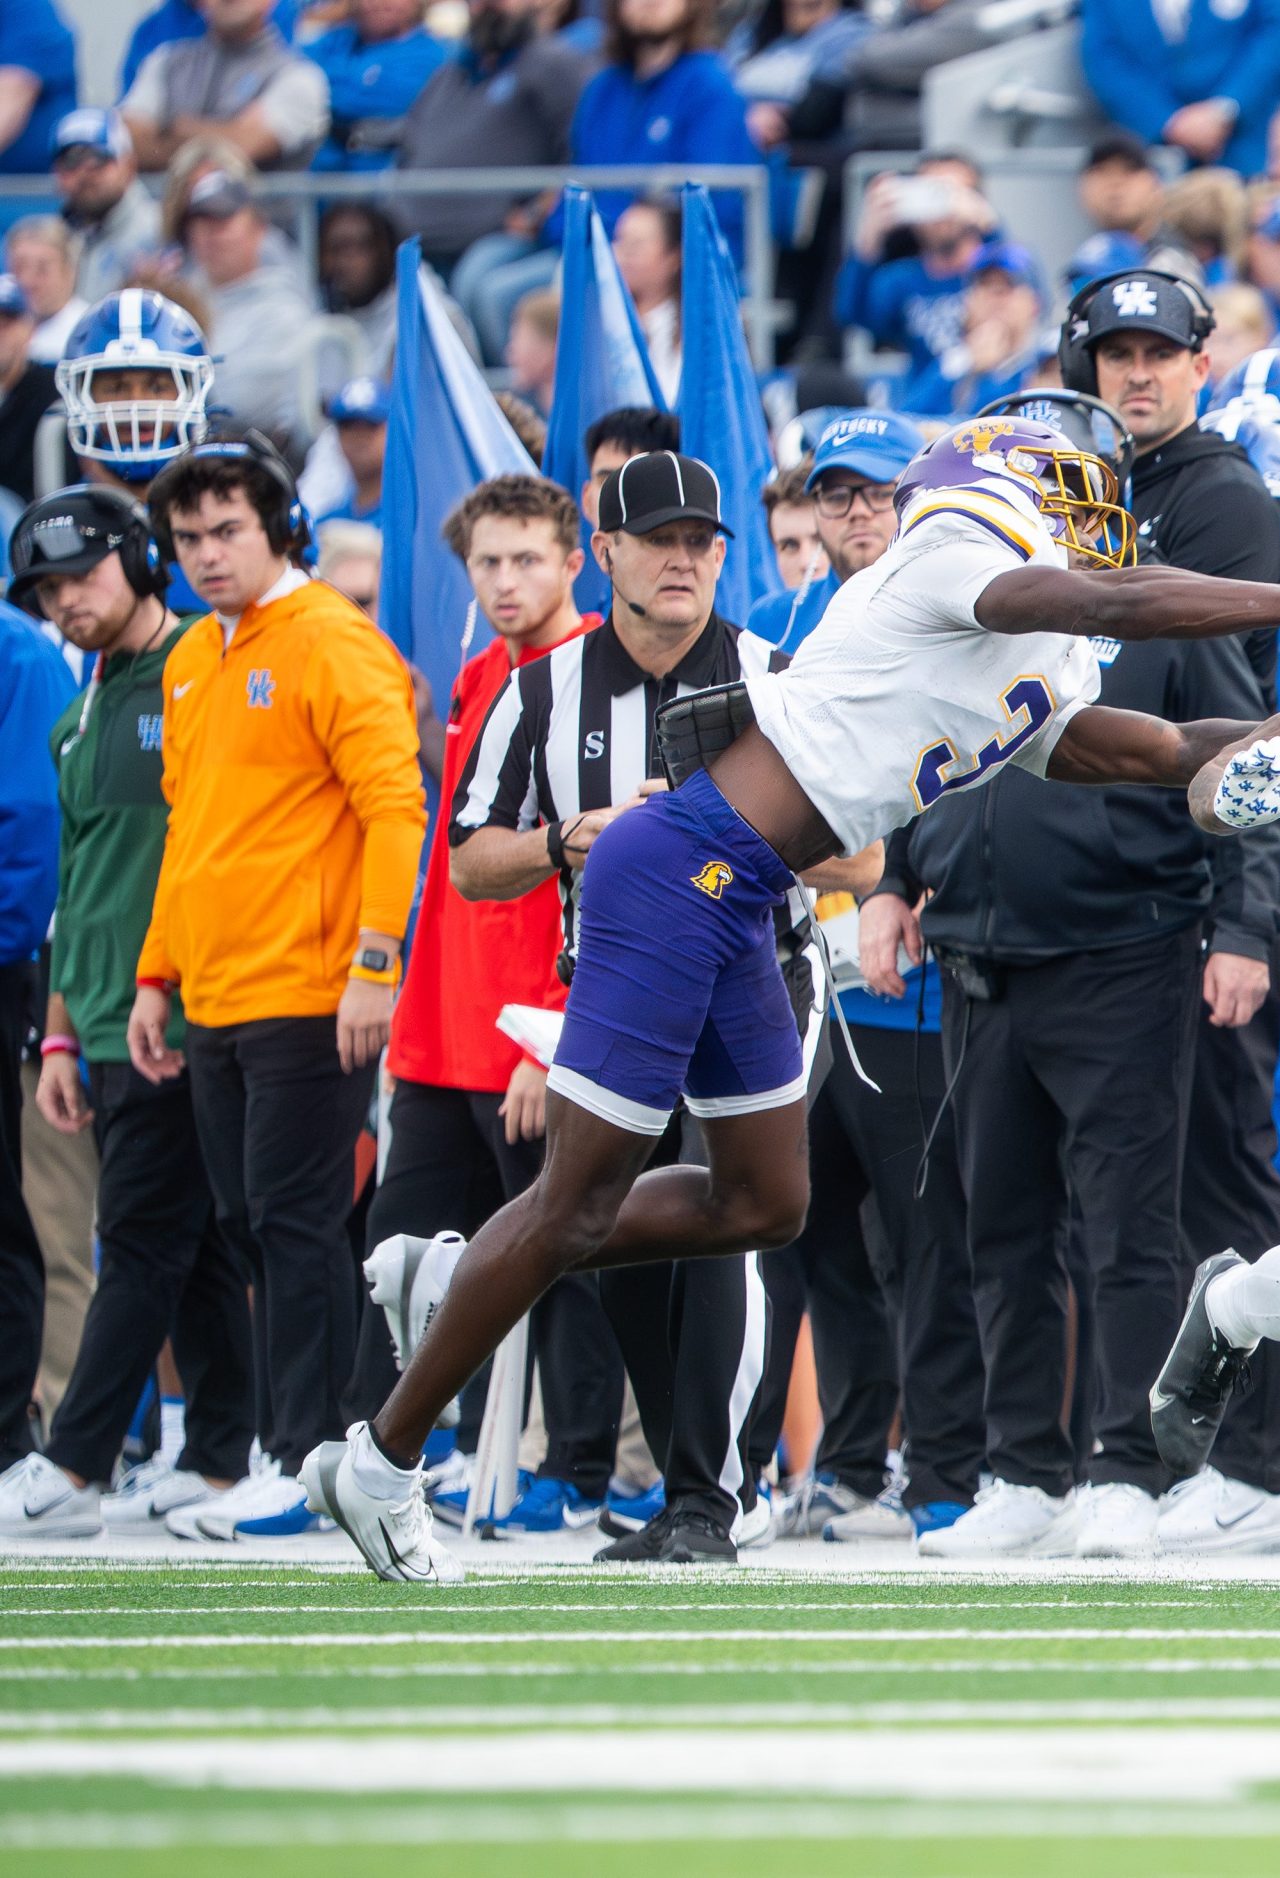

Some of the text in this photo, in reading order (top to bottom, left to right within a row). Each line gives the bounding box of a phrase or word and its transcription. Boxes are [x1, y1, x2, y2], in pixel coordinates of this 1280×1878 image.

[1113, 281, 1157, 316] UK
[584, 730, 605, 760] S
[909, 674, 1057, 813] 3
